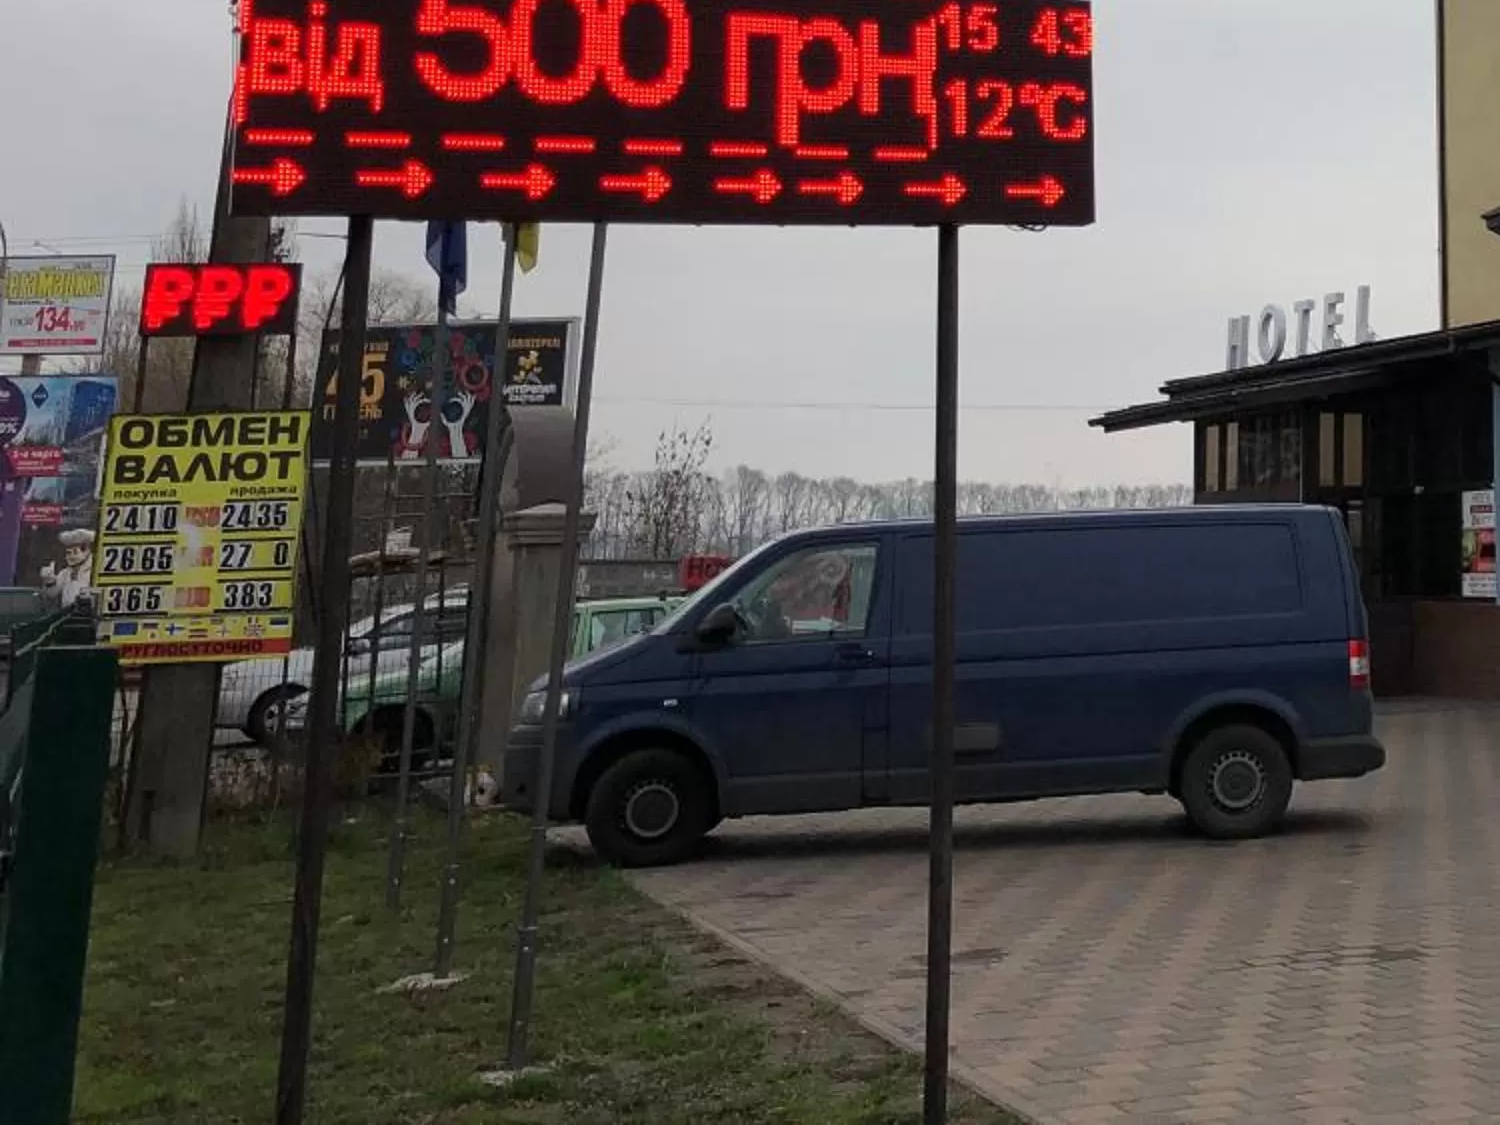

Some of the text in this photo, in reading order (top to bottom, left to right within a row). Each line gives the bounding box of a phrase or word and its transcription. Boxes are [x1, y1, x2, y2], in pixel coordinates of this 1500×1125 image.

[939, 0, 1093, 56] 15 43
[1226, 284, 1376, 370] HOTEL
[120, 417, 300, 449] ОБМЕН
[114, 451, 300, 484] ВАЛЮТ
[113, 488, 177, 500] покупка
[229, 485, 297, 497] продажа
[106, 506, 178, 531] 2410
[221, 503, 289, 528] 2435
[104, 546, 173, 572] 2665
[108, 587, 161, 611] 365
[225, 583, 273, 608] 383
